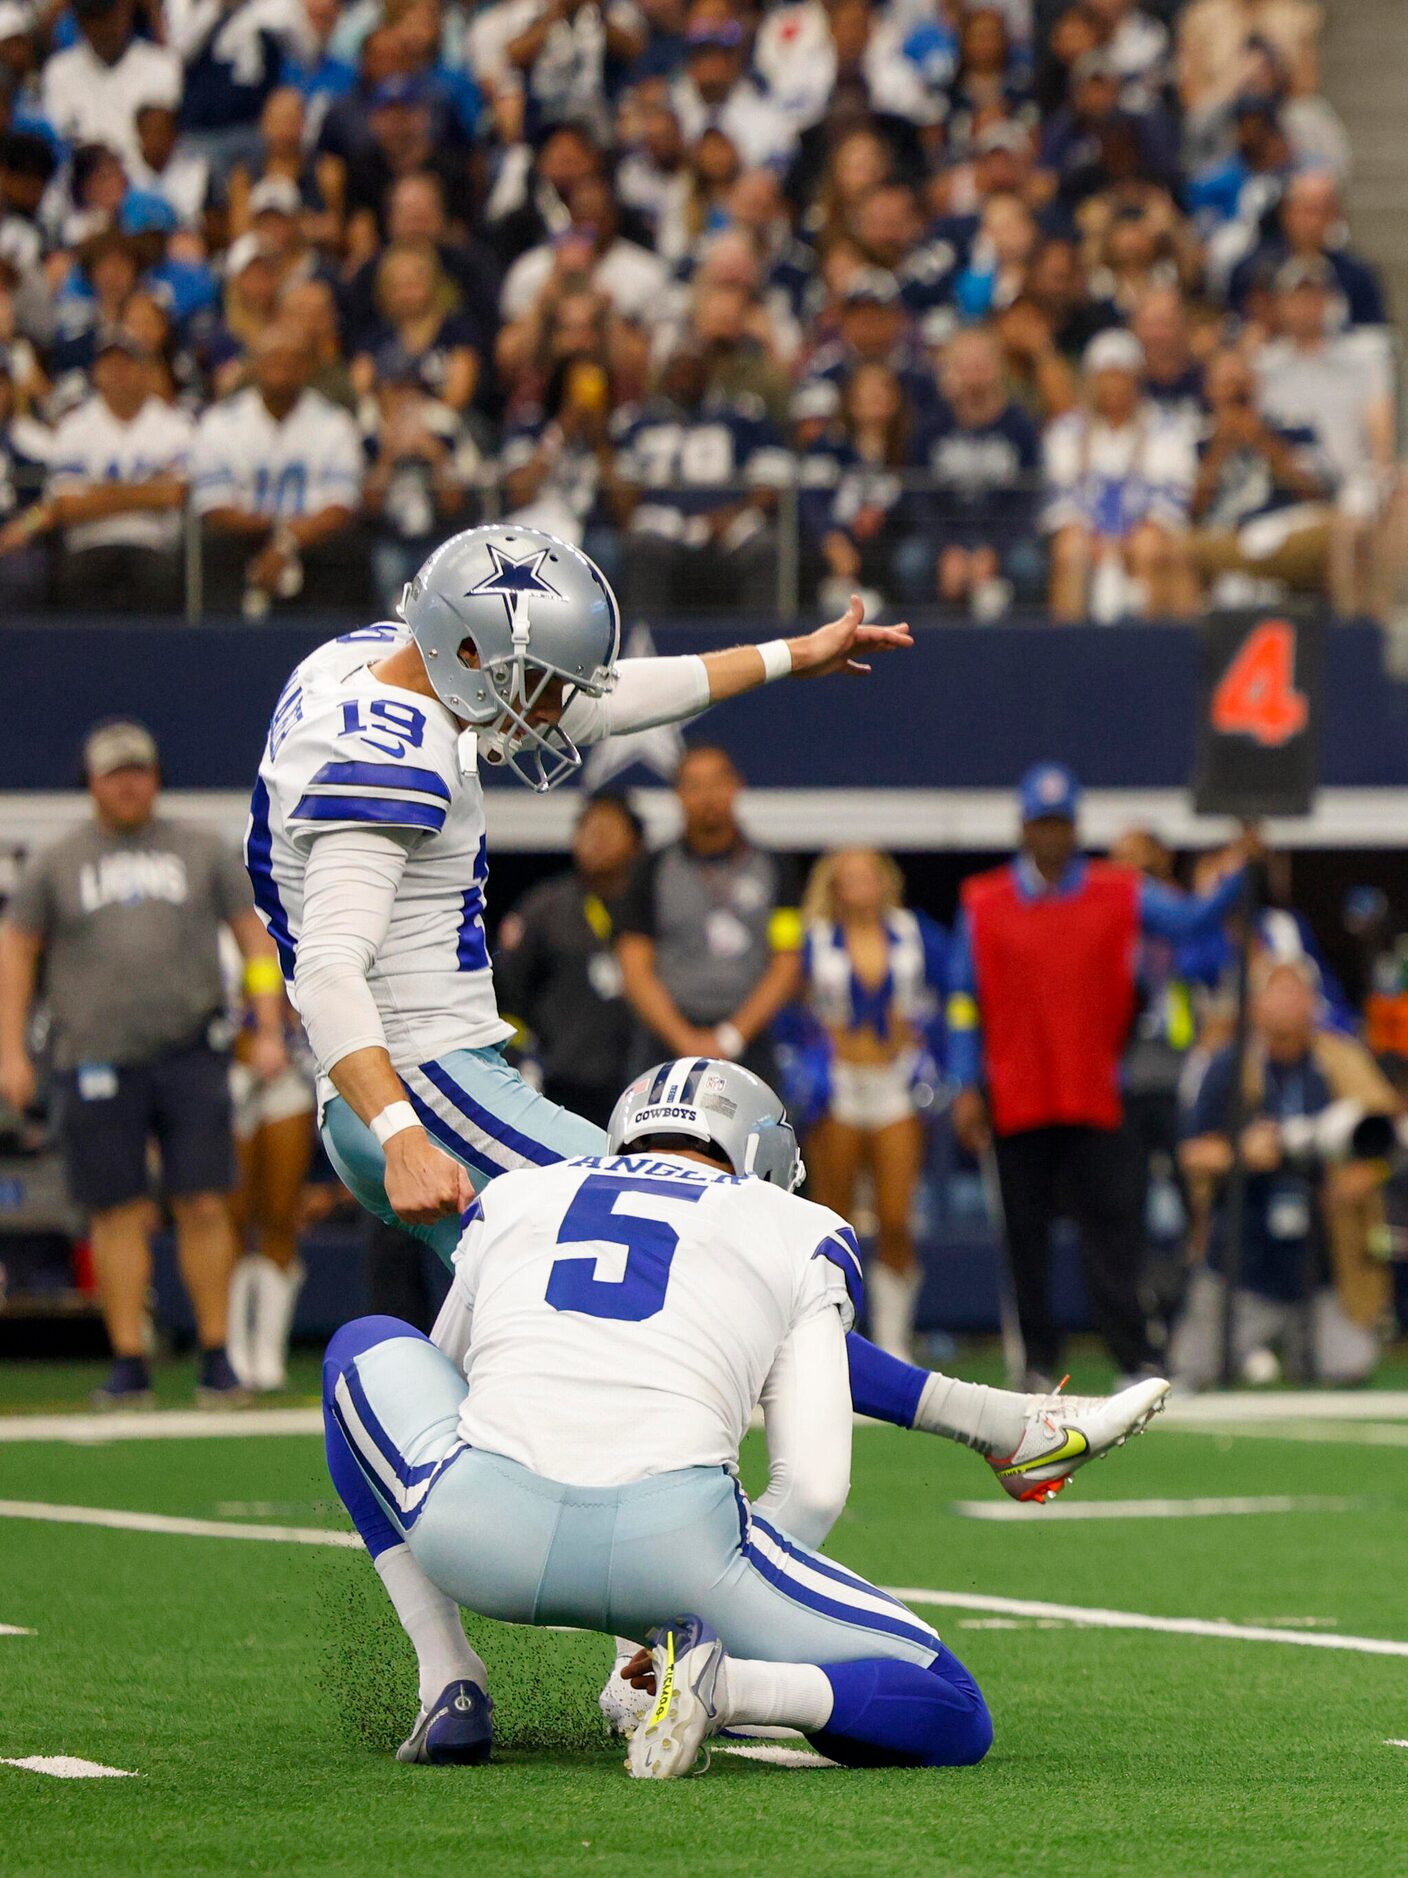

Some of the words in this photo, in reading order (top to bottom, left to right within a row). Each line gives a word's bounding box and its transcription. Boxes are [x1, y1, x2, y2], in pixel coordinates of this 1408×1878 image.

[336, 699, 427, 748] 19
[1210, 618, 1309, 747] 4
[634, 1106, 698, 1124] COWBOYS
[544, 1173, 708, 1322] 5
